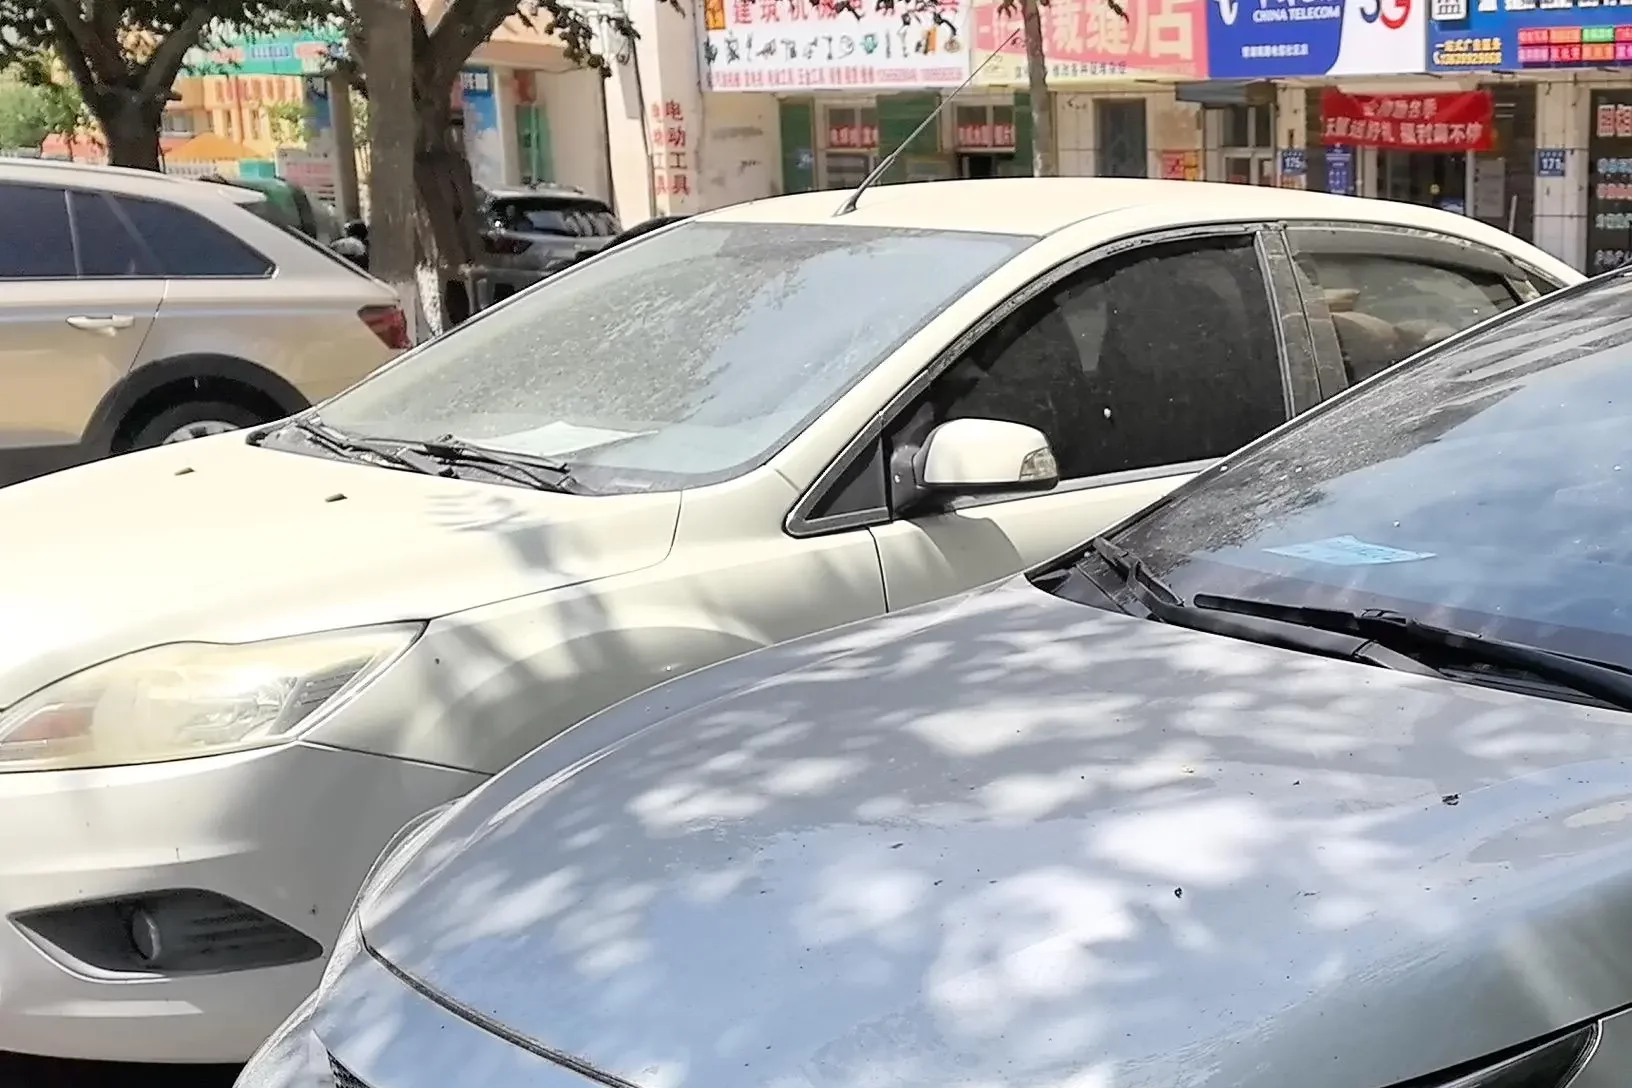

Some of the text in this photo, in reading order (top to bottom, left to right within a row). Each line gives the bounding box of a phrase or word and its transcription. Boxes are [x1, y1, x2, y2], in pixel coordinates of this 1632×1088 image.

[1253, 6, 1340, 23] CHINA TELECOM
[665, 100, 690, 196] 电动工具
[1541, 158, 1561, 170] 171
